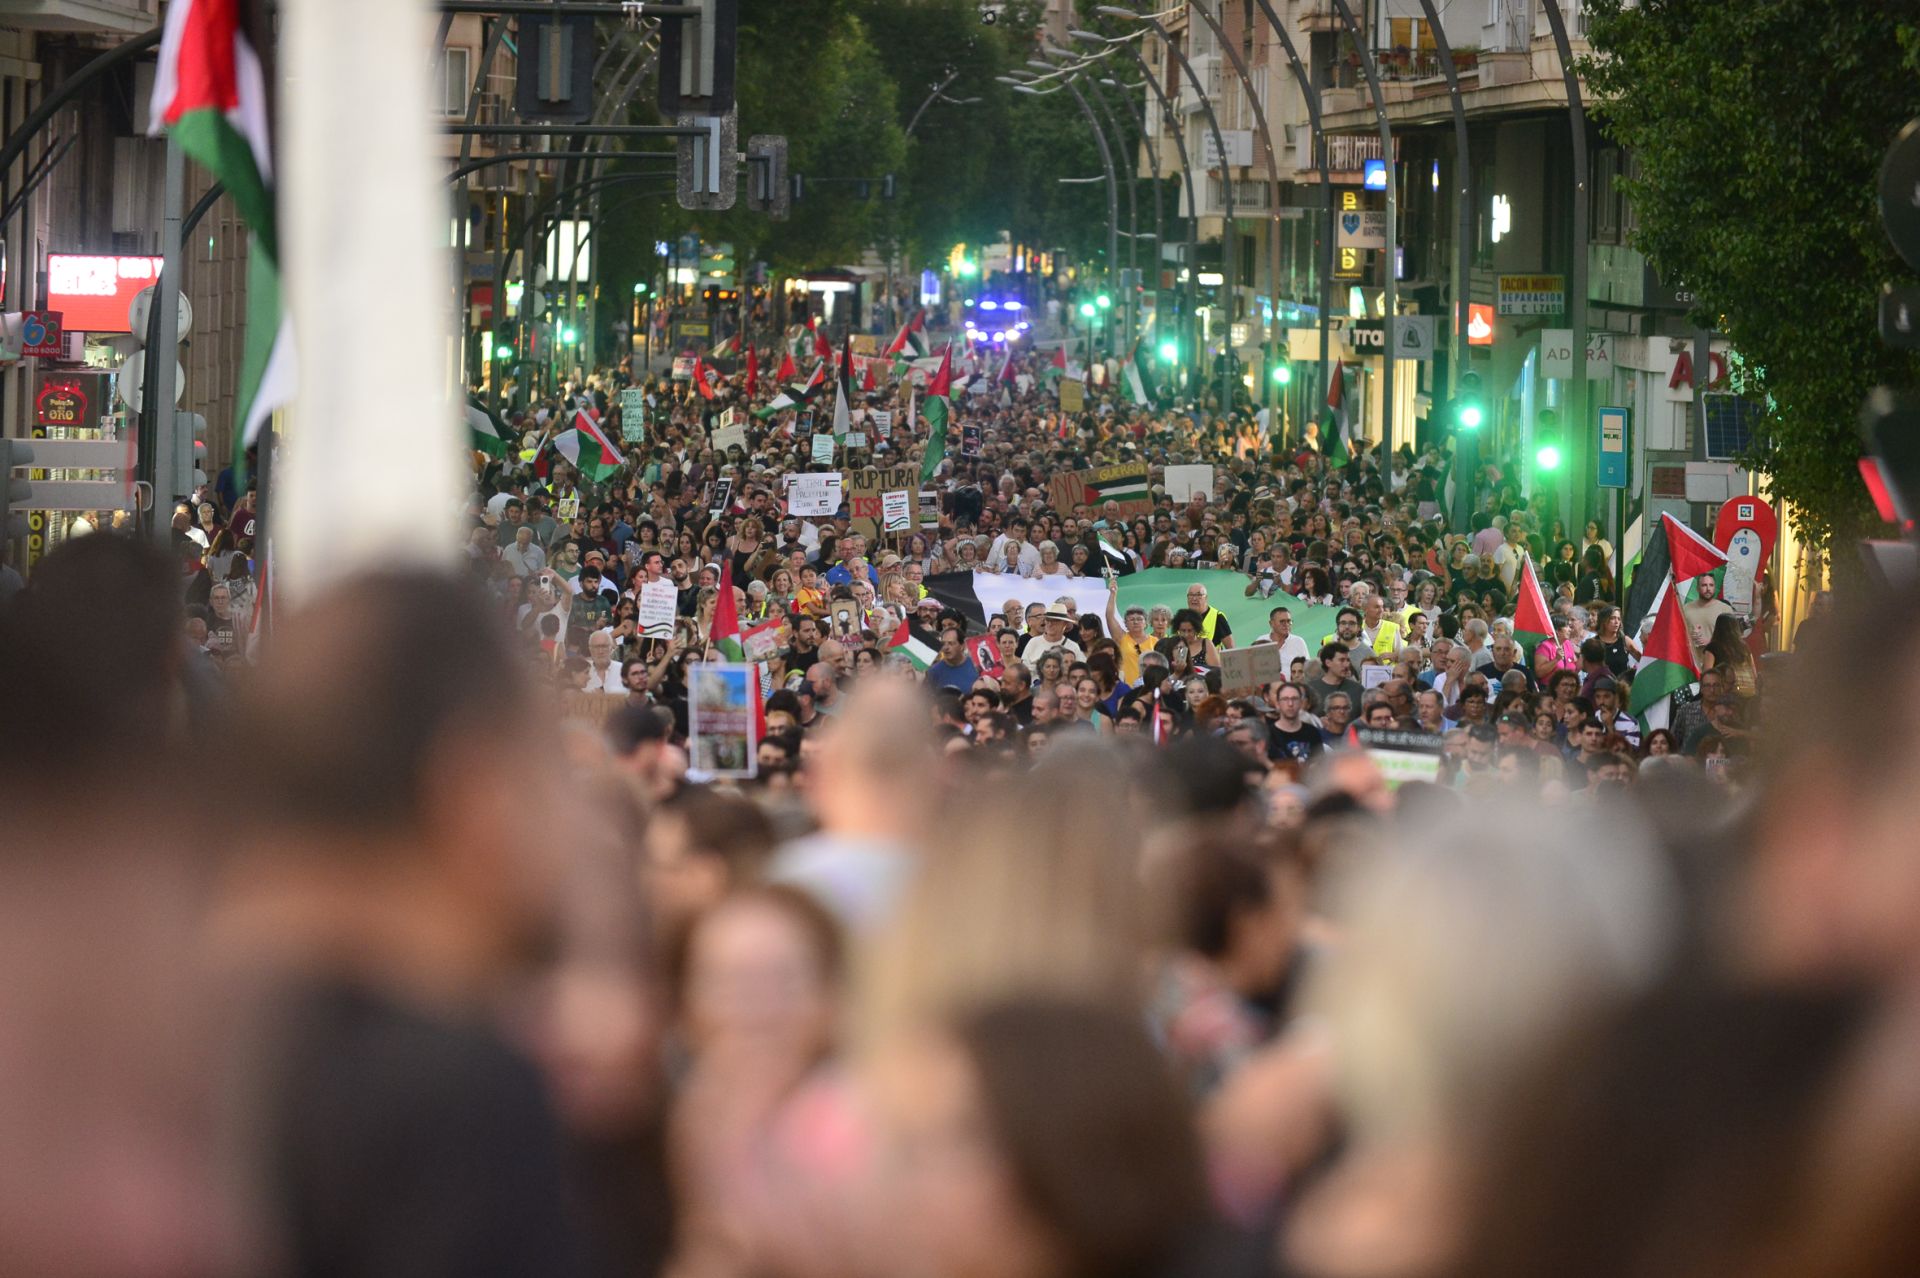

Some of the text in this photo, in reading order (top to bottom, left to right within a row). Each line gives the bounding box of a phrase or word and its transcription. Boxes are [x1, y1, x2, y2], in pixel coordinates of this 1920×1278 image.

[1502, 293, 1562, 302] REPARACION
[1501, 303, 1513, 313] DE
[1354, 330, 1385, 346] Tra
[1546, 348, 1608, 361] ADRA
[49, 410, 74, 420] ORO
[853, 468, 915, 490] RUPTURA
[1099, 463, 1145, 480] GUERRA
[1054, 473, 1081, 505] NO
[851, 495, 883, 518] ISR
